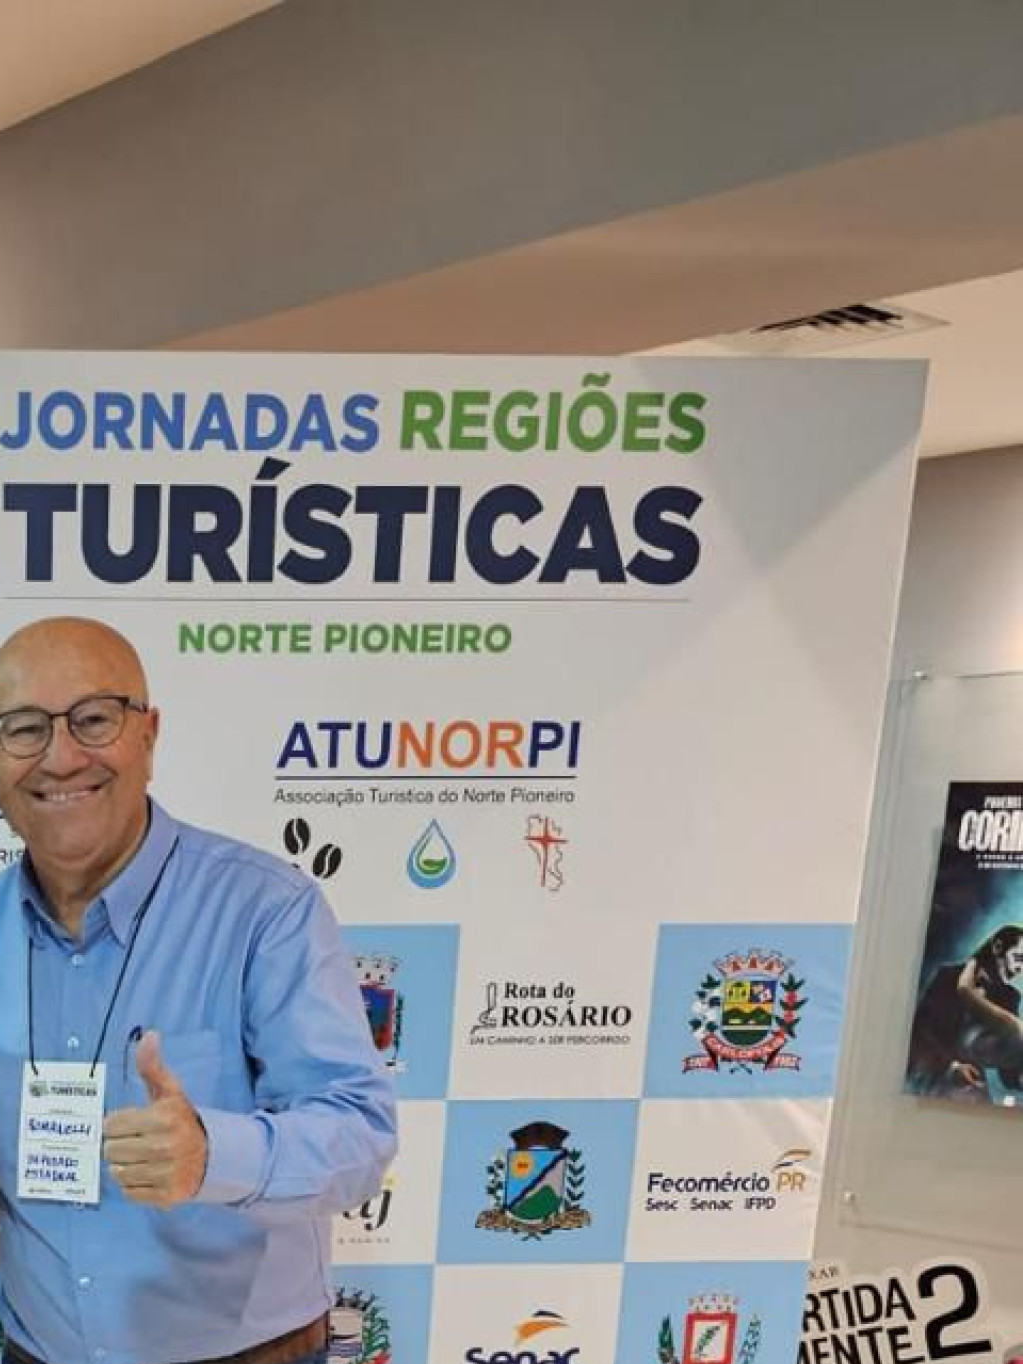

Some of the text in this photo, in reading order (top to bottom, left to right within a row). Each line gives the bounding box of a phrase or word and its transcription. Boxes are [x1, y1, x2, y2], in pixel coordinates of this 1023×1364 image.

[0, 373, 707, 453] JORNADAS REGIÕES
[3, 456, 704, 585] TURÍSTICAS
[179, 623, 512, 653] NORTE PIONEIRO
[276, 721, 581, 769] ATUNORPI
[274, 787, 364, 808] Associação
[439, 788, 458, 803] do
[462, 788, 505, 803] Norte
[511, 787, 575, 803] Pioneiro
[504, 981, 576, 999] Rota do
[501, 1000, 633, 1028] ROSÁRIO
[647, 1171, 806, 1193] Fecomércio PR
[645, 1197, 678, 1211] Sesc
[690, 1197, 734, 1211] Senac
[918, 1264, 993, 1360] 2
